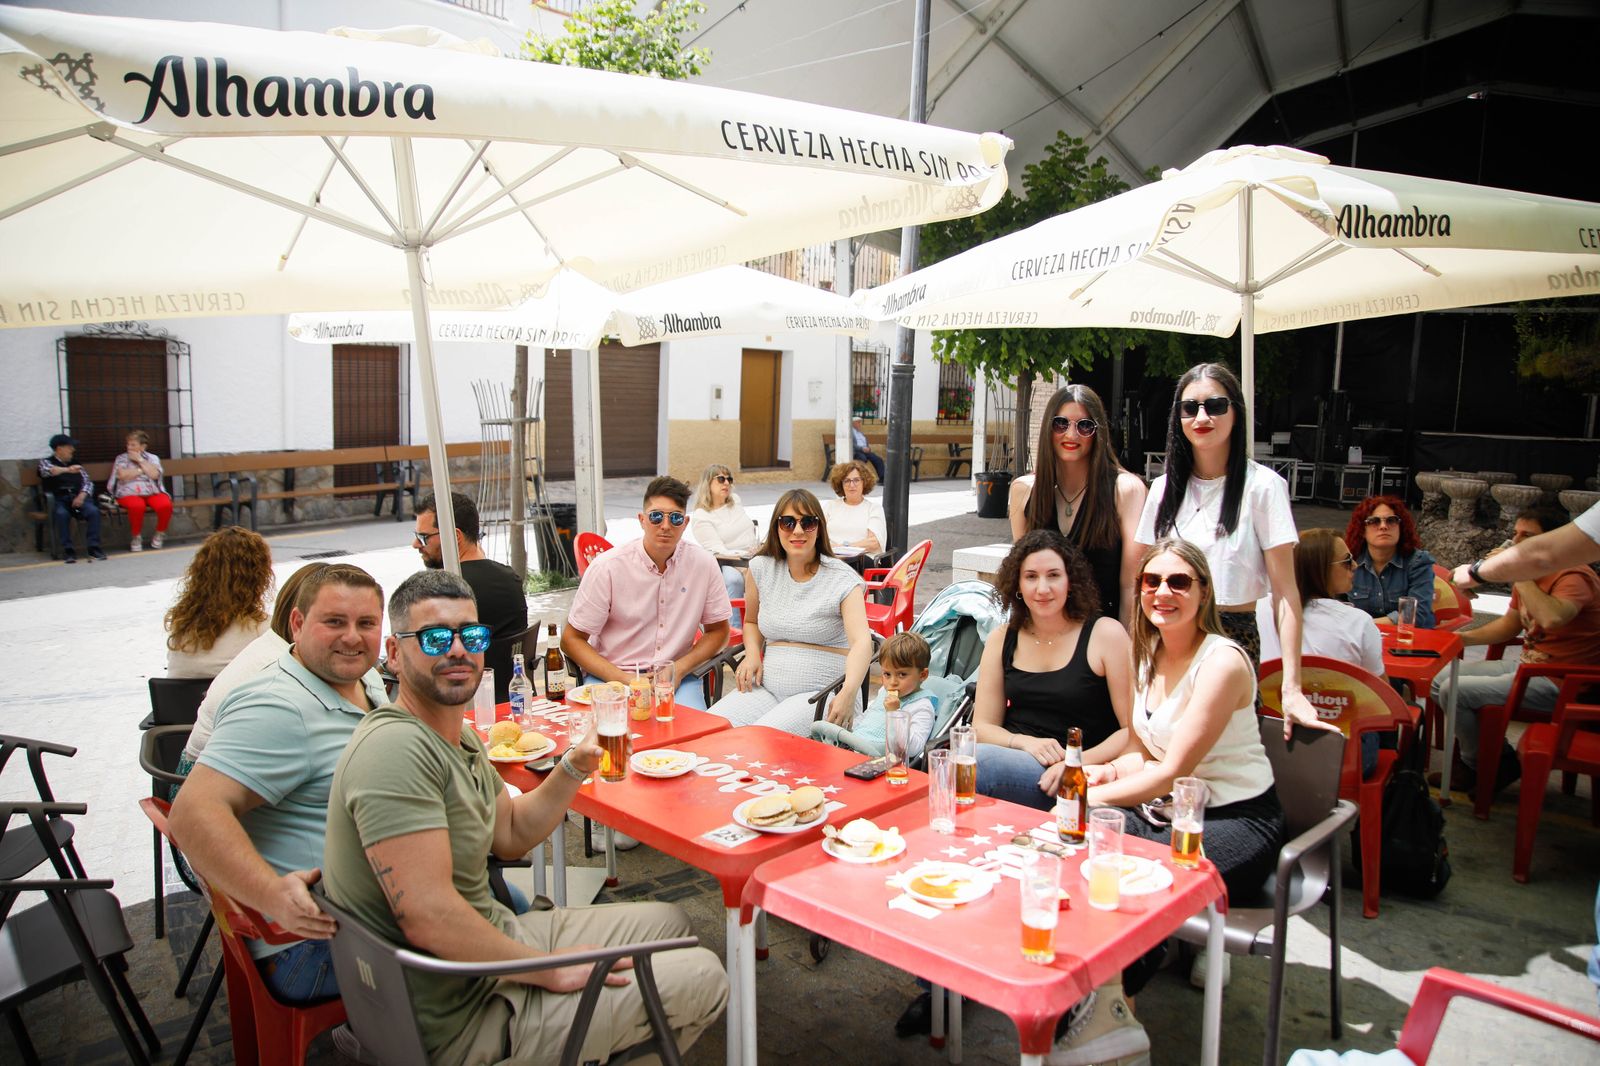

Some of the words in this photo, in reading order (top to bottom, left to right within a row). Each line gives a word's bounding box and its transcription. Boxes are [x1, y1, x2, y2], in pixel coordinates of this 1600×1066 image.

[124, 55, 436, 124] Alhambra
[720, 120, 835, 161] CERVEZA
[839, 136, 916, 173] HECHA
[919, 151, 952, 182] SIN
[1334, 204, 1451, 239] Alhambra
[1012, 252, 1065, 281] CERVEZA
[1069, 244, 1121, 272] HECHA
[882, 283, 927, 316] Alhambra
[312, 320, 363, 338] Alhambra
[438, 323, 483, 338] CERVEZA
[486, 325, 521, 341] HECHA
[525, 328, 546, 343] SIN
[552, 331, 585, 346] PRIS
[659, 312, 721, 336] Alhambra
[785, 315, 818, 329] CERVEZA
[818, 315, 843, 329] HECHA
[843, 315, 855, 329] SIN
